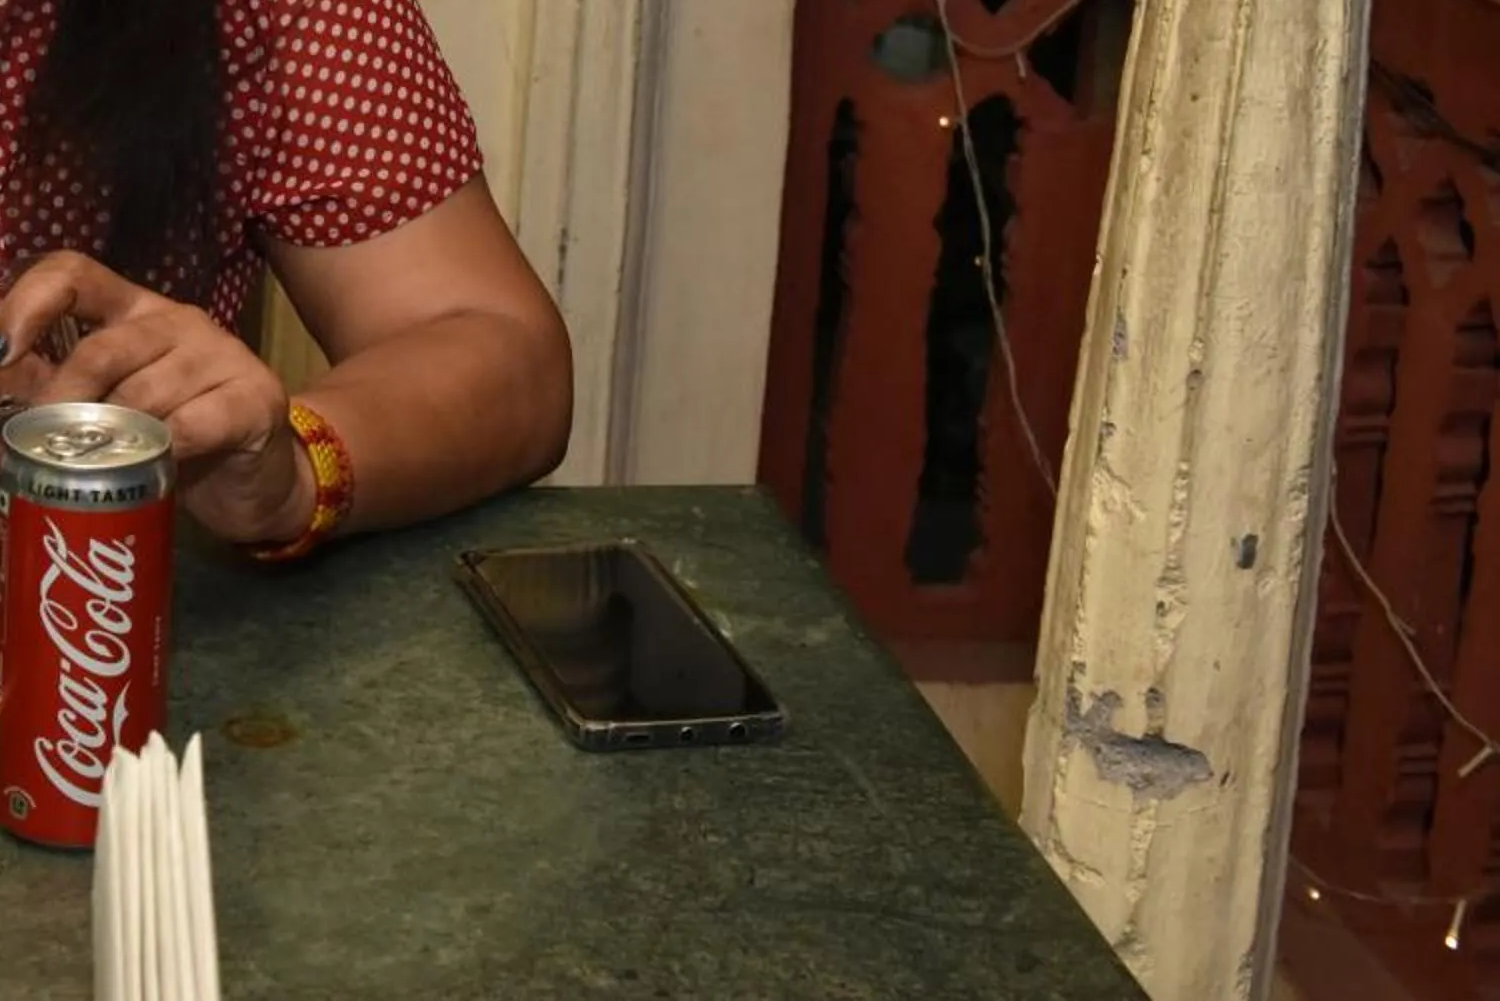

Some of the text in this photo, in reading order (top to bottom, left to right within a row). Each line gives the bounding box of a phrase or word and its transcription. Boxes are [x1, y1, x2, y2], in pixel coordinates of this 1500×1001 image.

[27, 480, 148, 503] LIGHT TASTE
[34, 516, 134, 808] Coca-Cola
